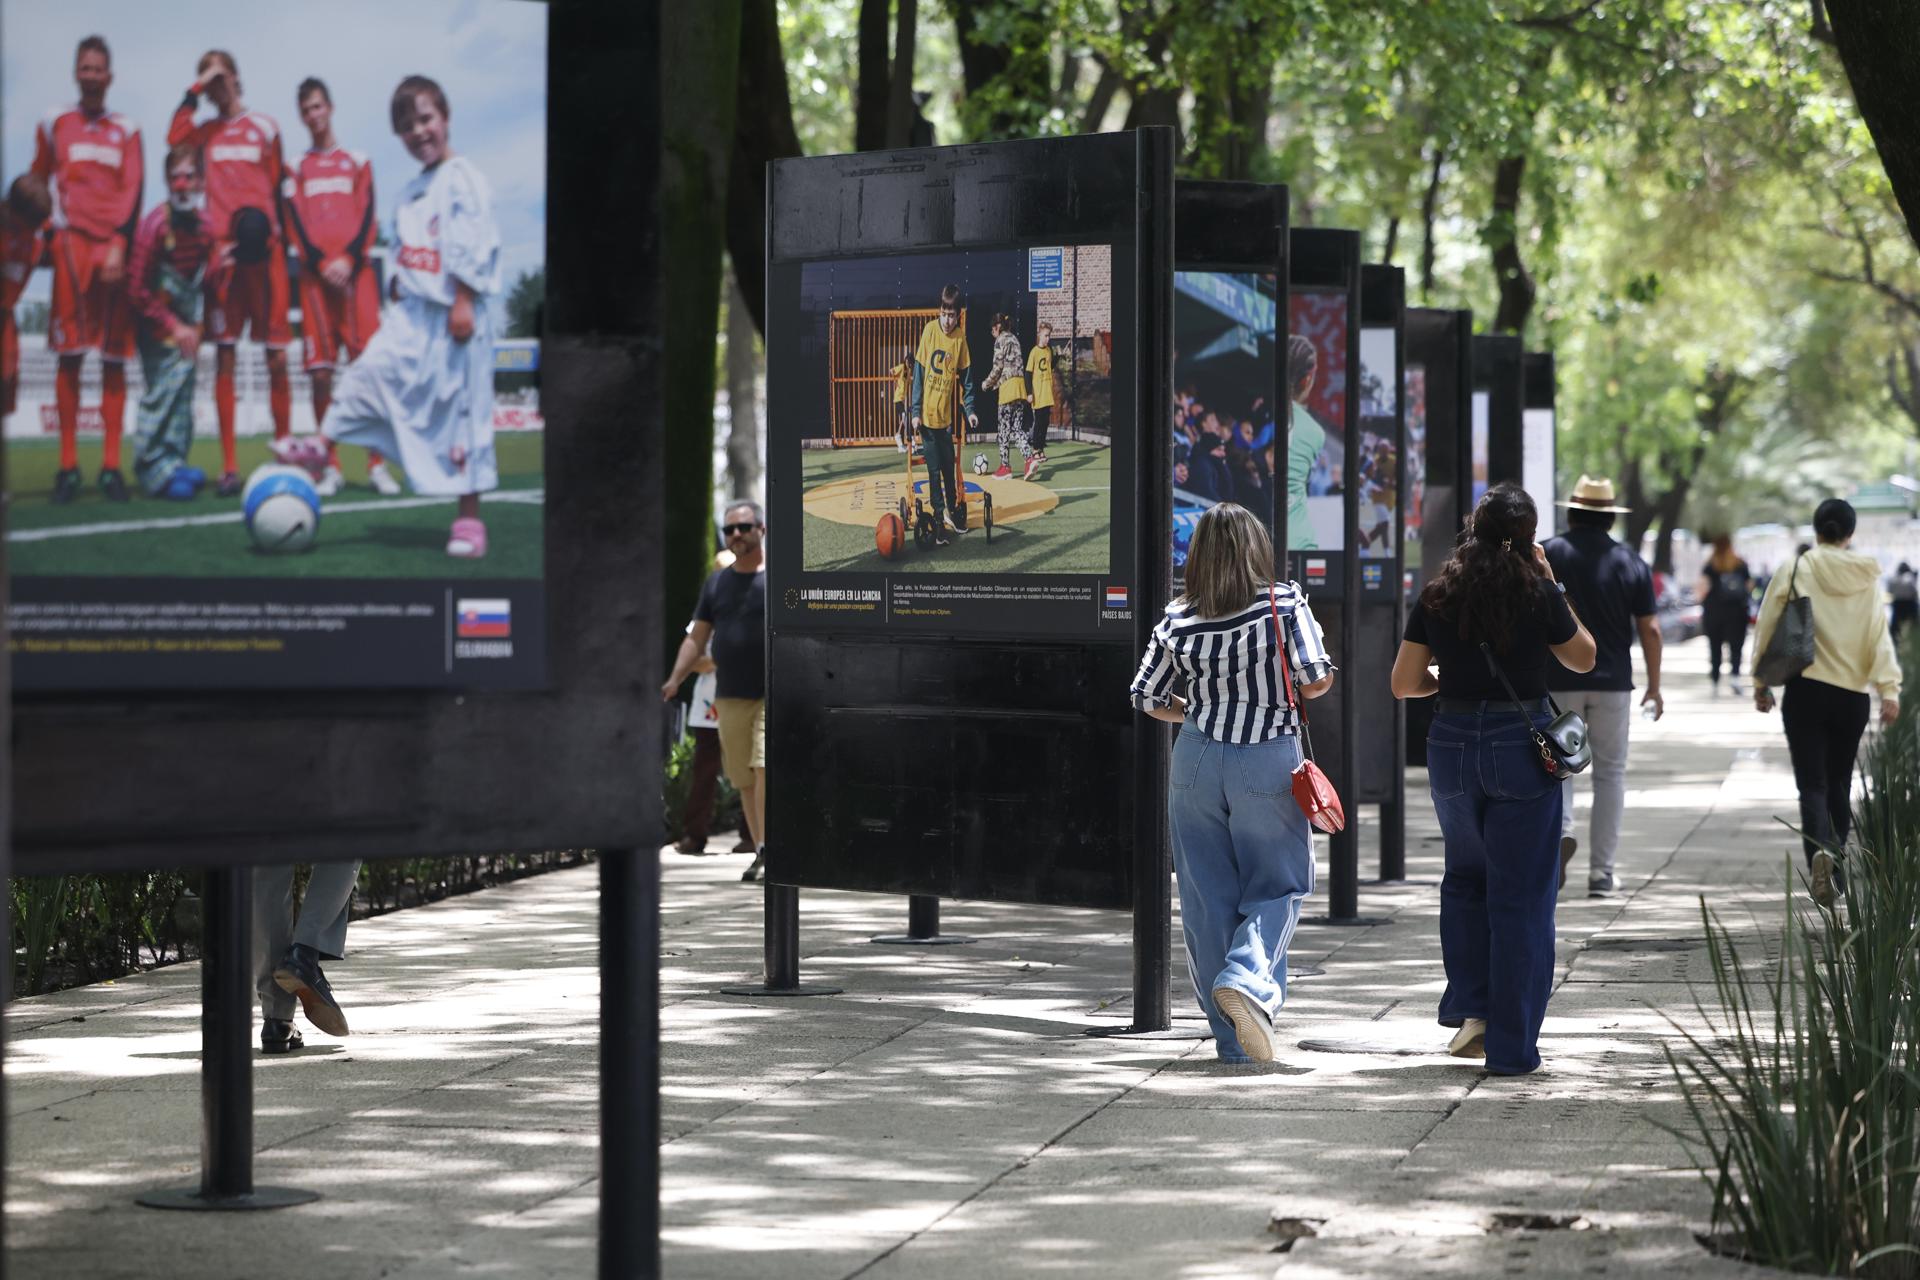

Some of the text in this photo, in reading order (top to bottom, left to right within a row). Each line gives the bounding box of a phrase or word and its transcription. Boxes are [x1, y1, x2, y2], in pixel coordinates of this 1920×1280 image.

[800, 587, 881, 601] LA UNIÓN EUROPEA EN LA CANCHA
[1102, 609, 1132, 620] PAÍSES BAJOS
